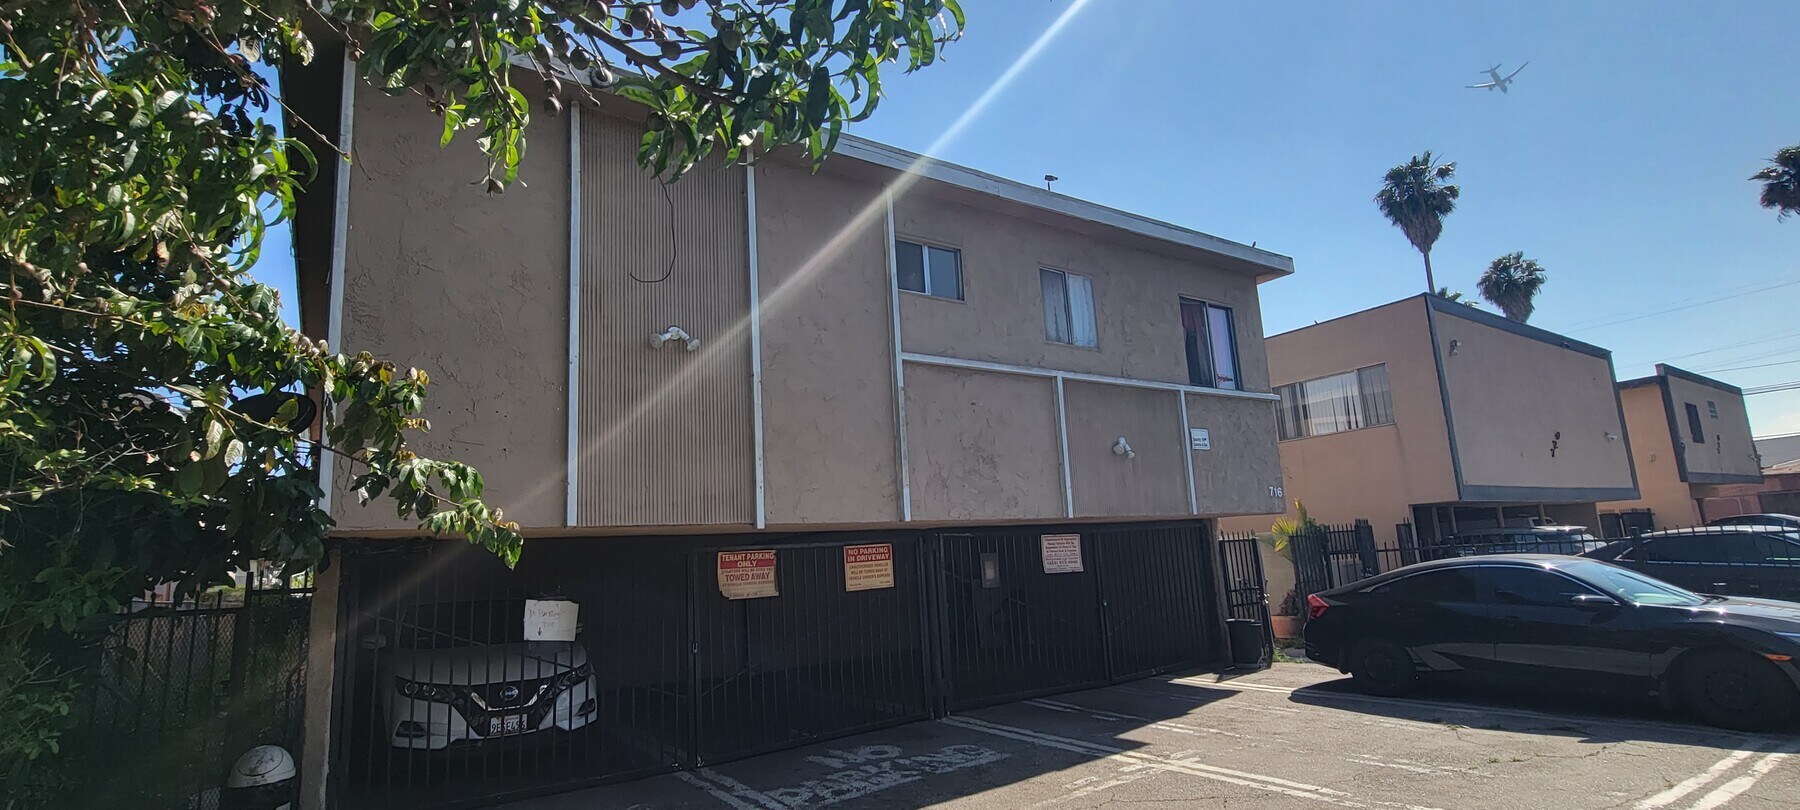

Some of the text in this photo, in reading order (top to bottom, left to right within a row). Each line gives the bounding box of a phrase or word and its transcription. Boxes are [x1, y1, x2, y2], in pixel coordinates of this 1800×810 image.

[1268, 486, 1283, 498] 716
[860, 547, 888, 555] PARKING
[722, 554, 746, 562] TENANT
[856, 553, 890, 562] DRIVEWAY
[725, 572, 770, 582] TOWED AWAY
[803, 744, 902, 769] NO
[762, 745, 1010, 806] PARKING
